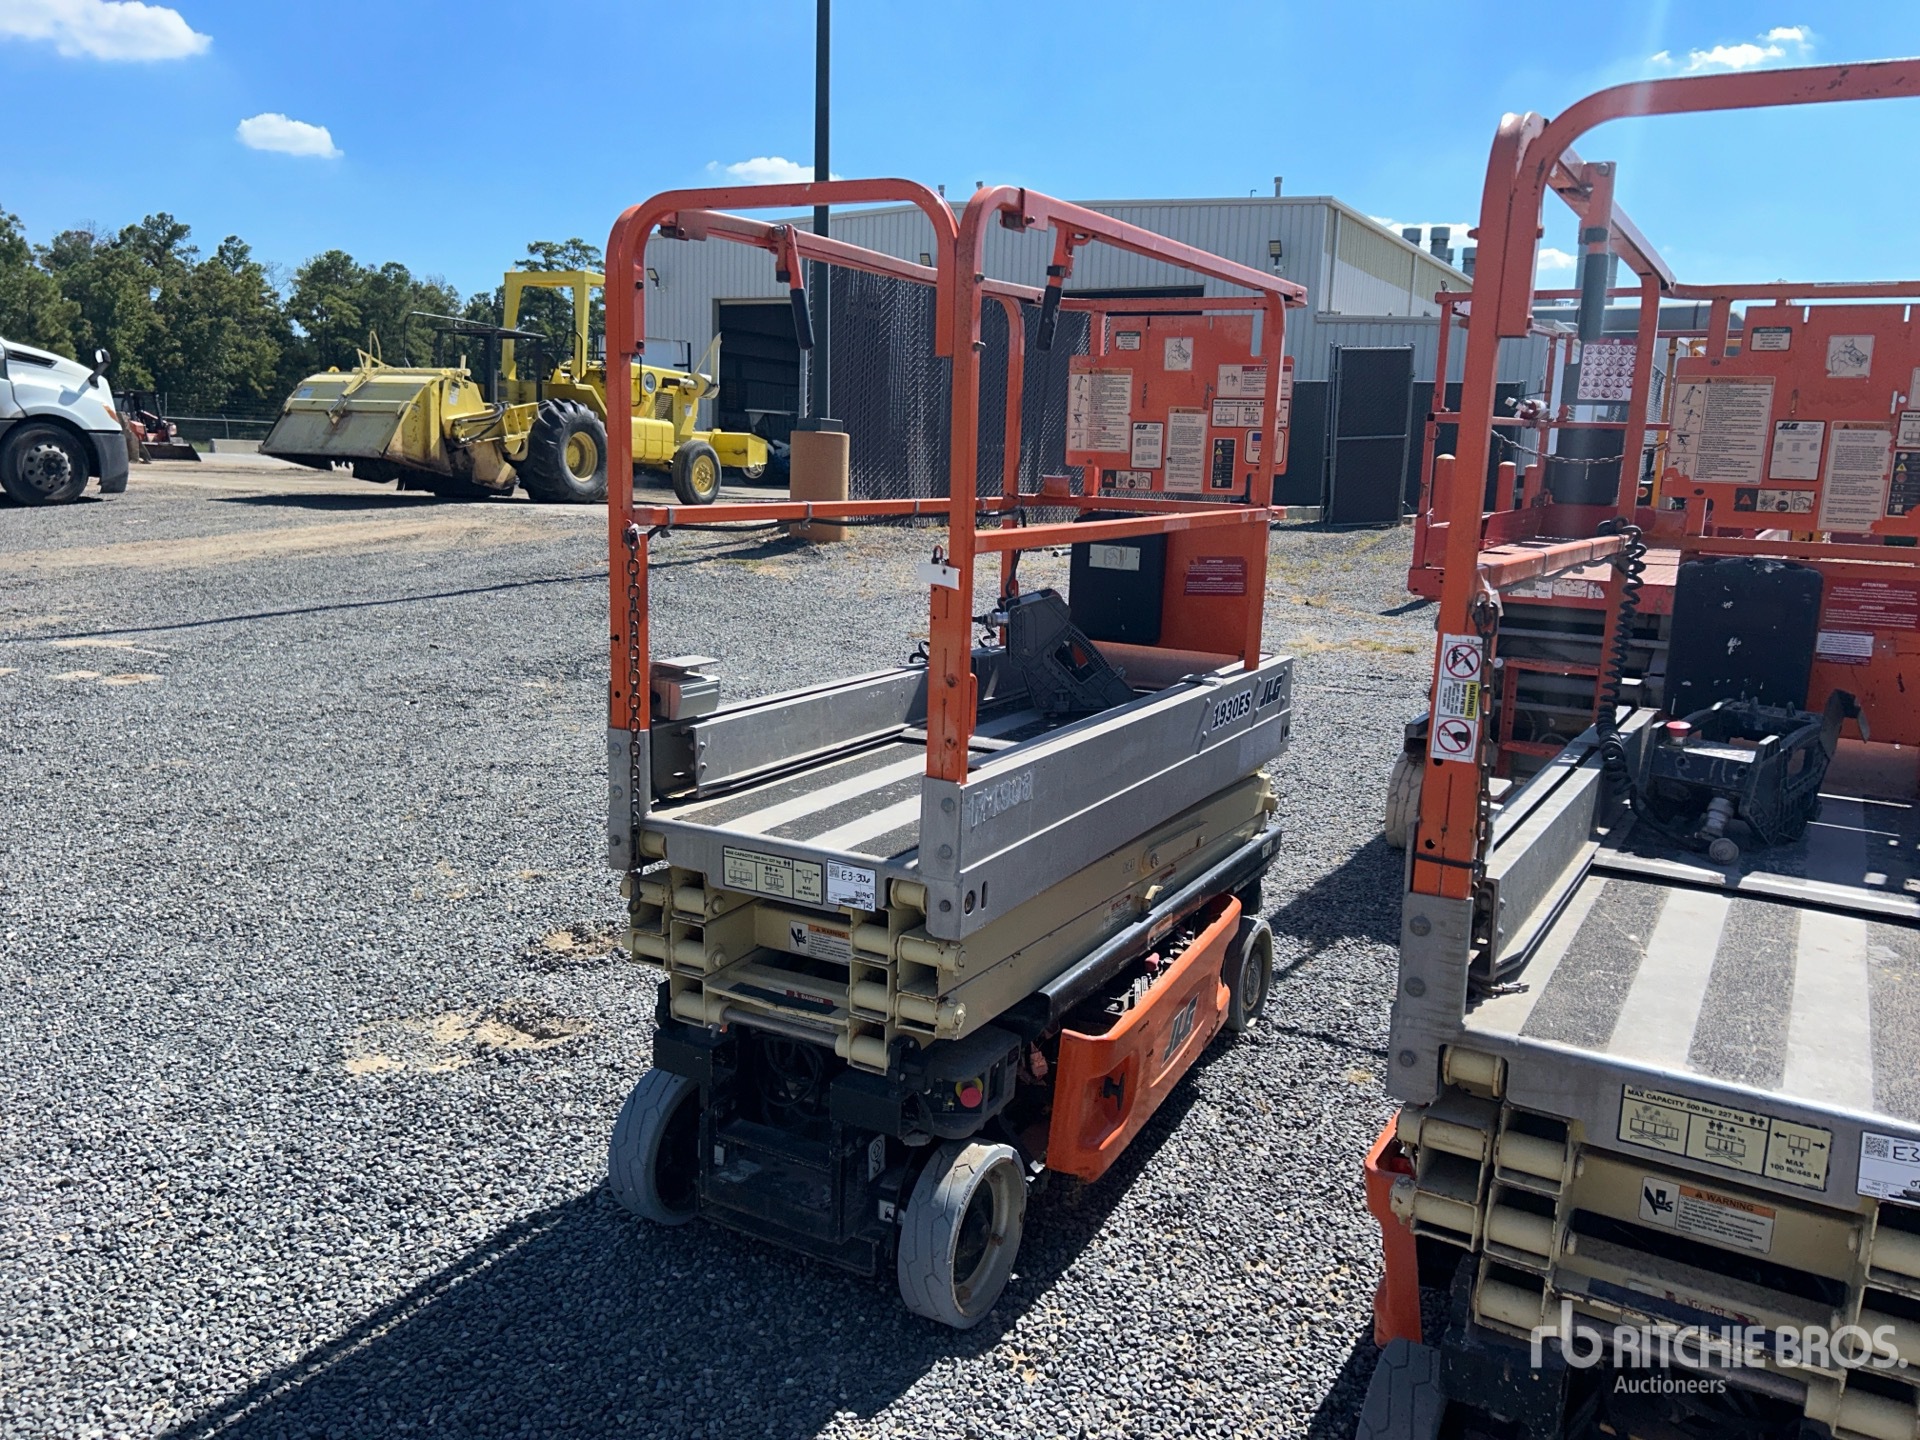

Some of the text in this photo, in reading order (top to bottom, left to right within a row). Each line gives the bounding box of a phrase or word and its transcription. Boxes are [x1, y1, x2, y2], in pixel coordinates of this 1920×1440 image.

[1260, 674, 1284, 709] JLG
[1466, 684, 1476, 716] WARNING
[1212, 690, 1252, 729] 1930ES
[734, 851, 753, 859] CAPACITY
[801, 994, 824, 1004] DANGER
[1627, 1089, 1644, 1098] MAX
[1646, 1094, 1684, 1108] CAPACITY
[1734, 1113, 1744, 1122] kg
[1770, 1163, 1784, 1171] 100
[1785, 1158, 1804, 1168] MAX
[1707, 1192, 1754, 1212] WARNING
